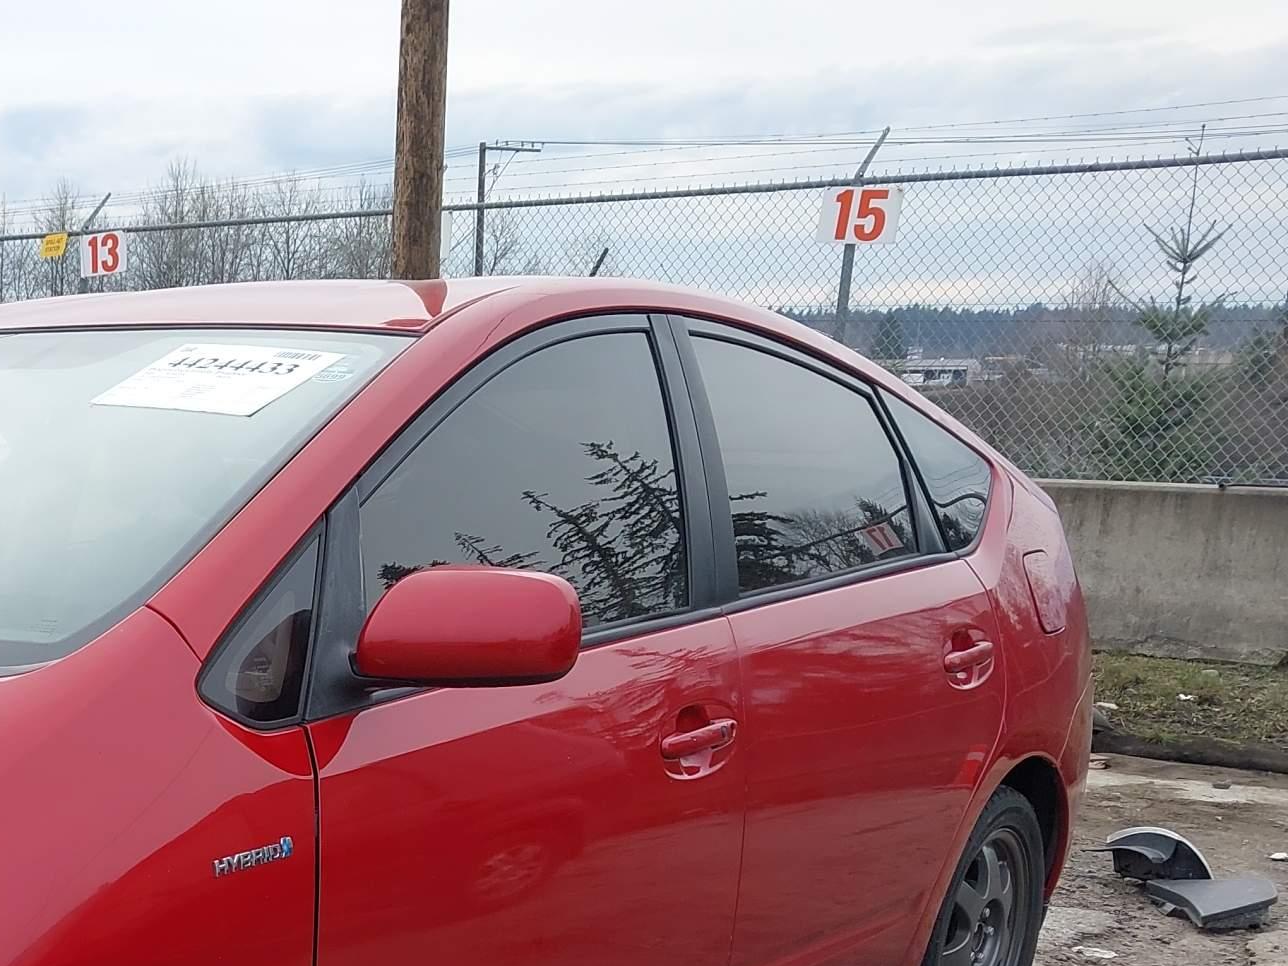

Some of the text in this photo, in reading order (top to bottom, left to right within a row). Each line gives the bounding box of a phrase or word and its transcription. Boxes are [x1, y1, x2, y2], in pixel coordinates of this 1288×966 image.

[835, 188, 889, 242] 15
[88, 233, 119, 274] 13
[168, 356, 300, 375] 44244433
[213, 843, 281, 877] HYBRID
